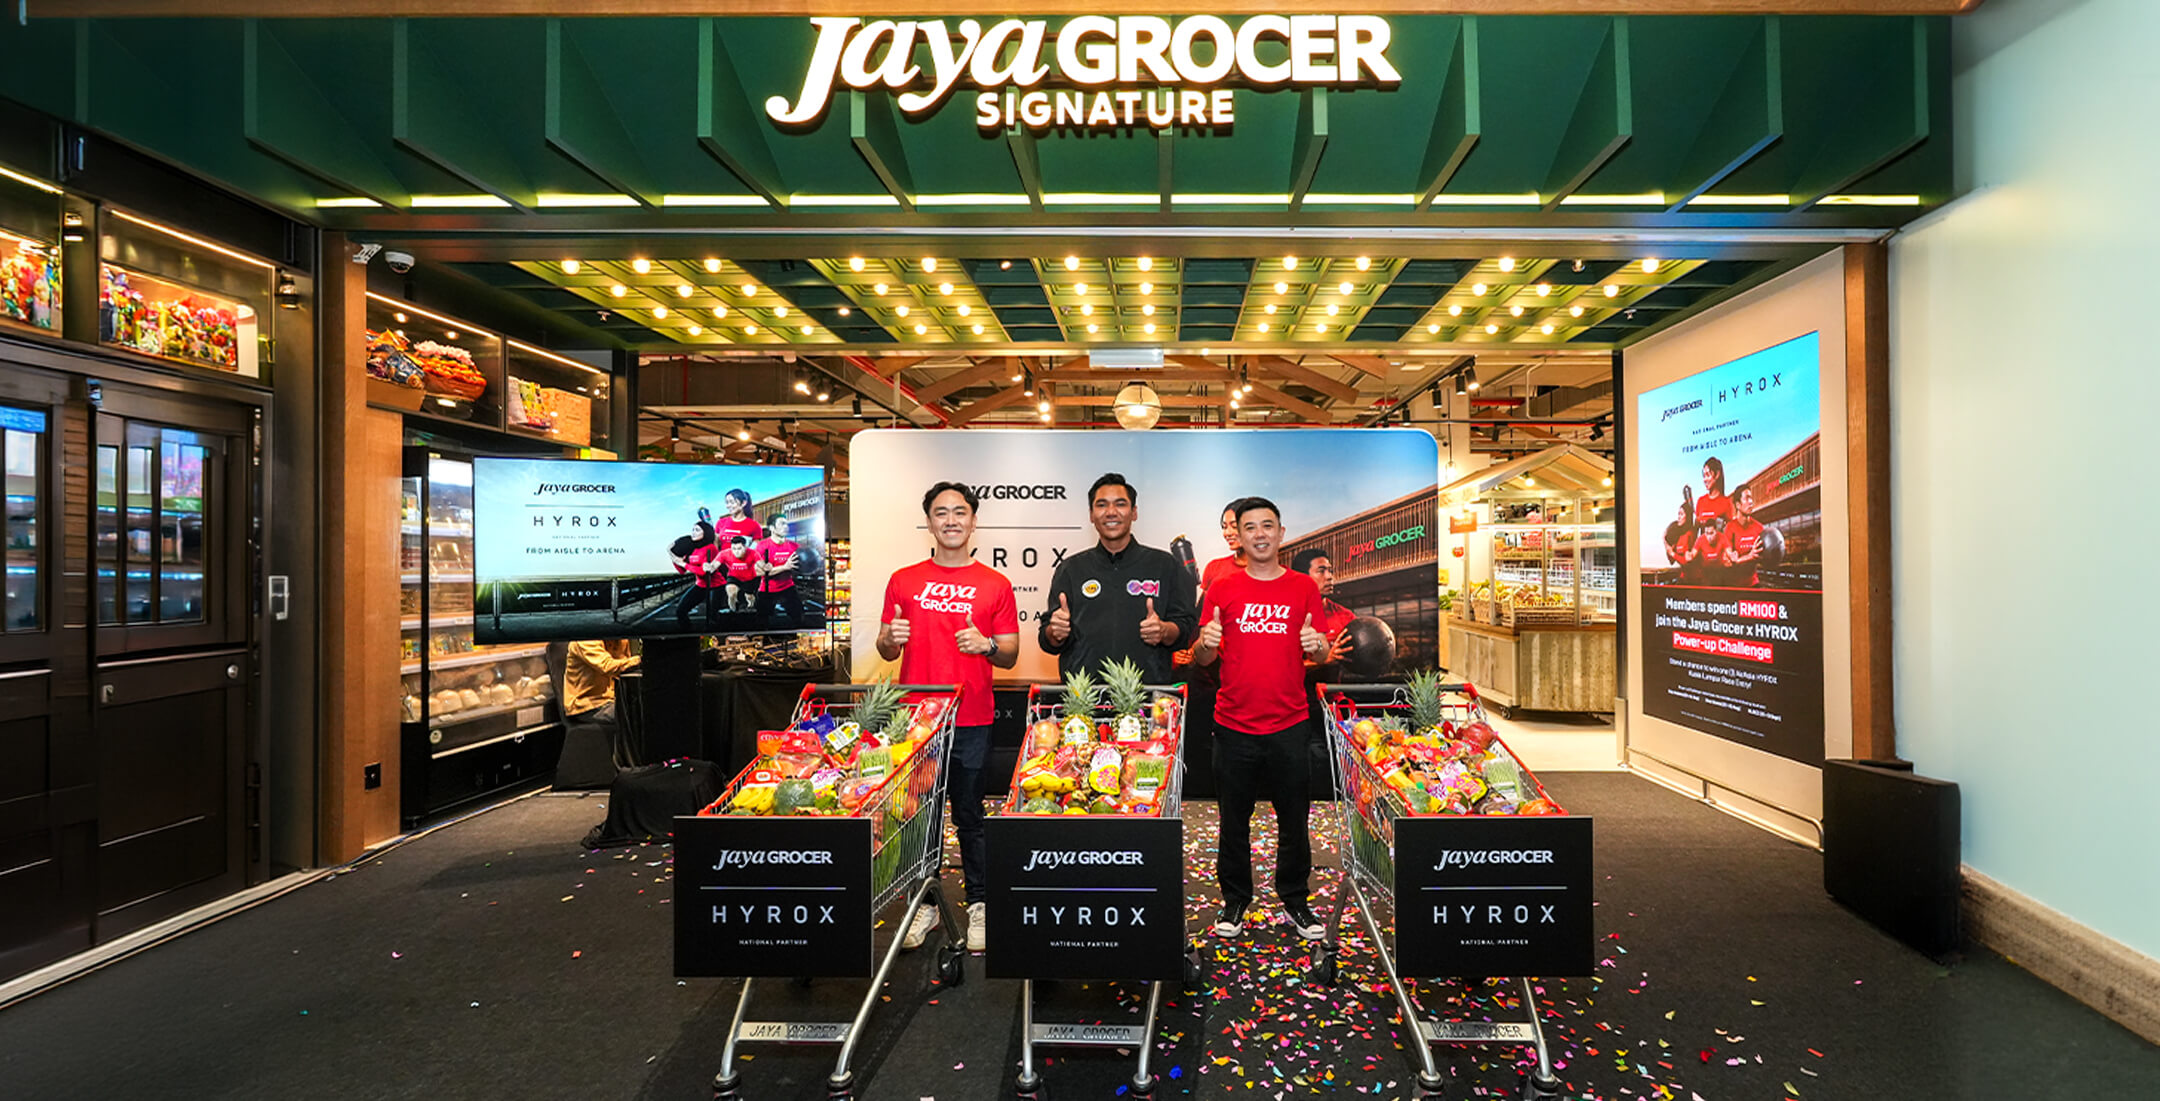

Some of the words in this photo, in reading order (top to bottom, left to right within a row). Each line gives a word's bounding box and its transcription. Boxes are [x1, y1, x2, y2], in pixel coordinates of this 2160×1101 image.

[765, 17, 1050, 123] Jaya
[1056, 15, 1402, 83] GROCER
[976, 89, 1235, 127] SIGNATURE
[1718, 372, 1781, 403] HYROX
[1719, 438, 1728, 446] TO
[534, 483, 571, 495] Jaya
[571, 484, 616, 493] GROCER
[992, 485, 1067, 499] GROCER
[533, 515, 617, 527] HYROX
[1375, 525, 1425, 549] GROCER
[913, 581, 977, 601] Jaya
[920, 599, 973, 614] GROCER
[1235, 603, 1291, 624] Jaya
[1665, 597, 1706, 612] Members
[1707, 602, 1738, 616] spend
[1739, 602, 1776, 618] RM100
[1778, 605, 1788, 619] &
[1240, 622, 1287, 634] GROCER
[1655, 614, 1671, 627] join
[1672, 616, 1686, 628] the
[1688, 617, 1710, 633] Jaya
[1711, 619, 1744, 635] Grocer
[1746, 626, 1753, 636] x
[1755, 624, 1799, 642] HYROX
[1673, 632, 1717, 652] Power-up
[1718, 638, 1772, 660] Challenge
[712, 850, 766, 870] Jaya
[766, 850, 833, 864] GROCER
[1023, 850, 1077, 871] Jaya
[1078, 851, 1144, 865] GROCER
[1433, 850, 1487, 871] Jaya
[1488, 850, 1554, 864] GROCER
[712, 905, 834, 924] HYROX
[1023, 906, 1146, 926] HYROX
[1433, 905, 1555, 924] HYROX
[749, 1025, 782, 1037] JAYA
